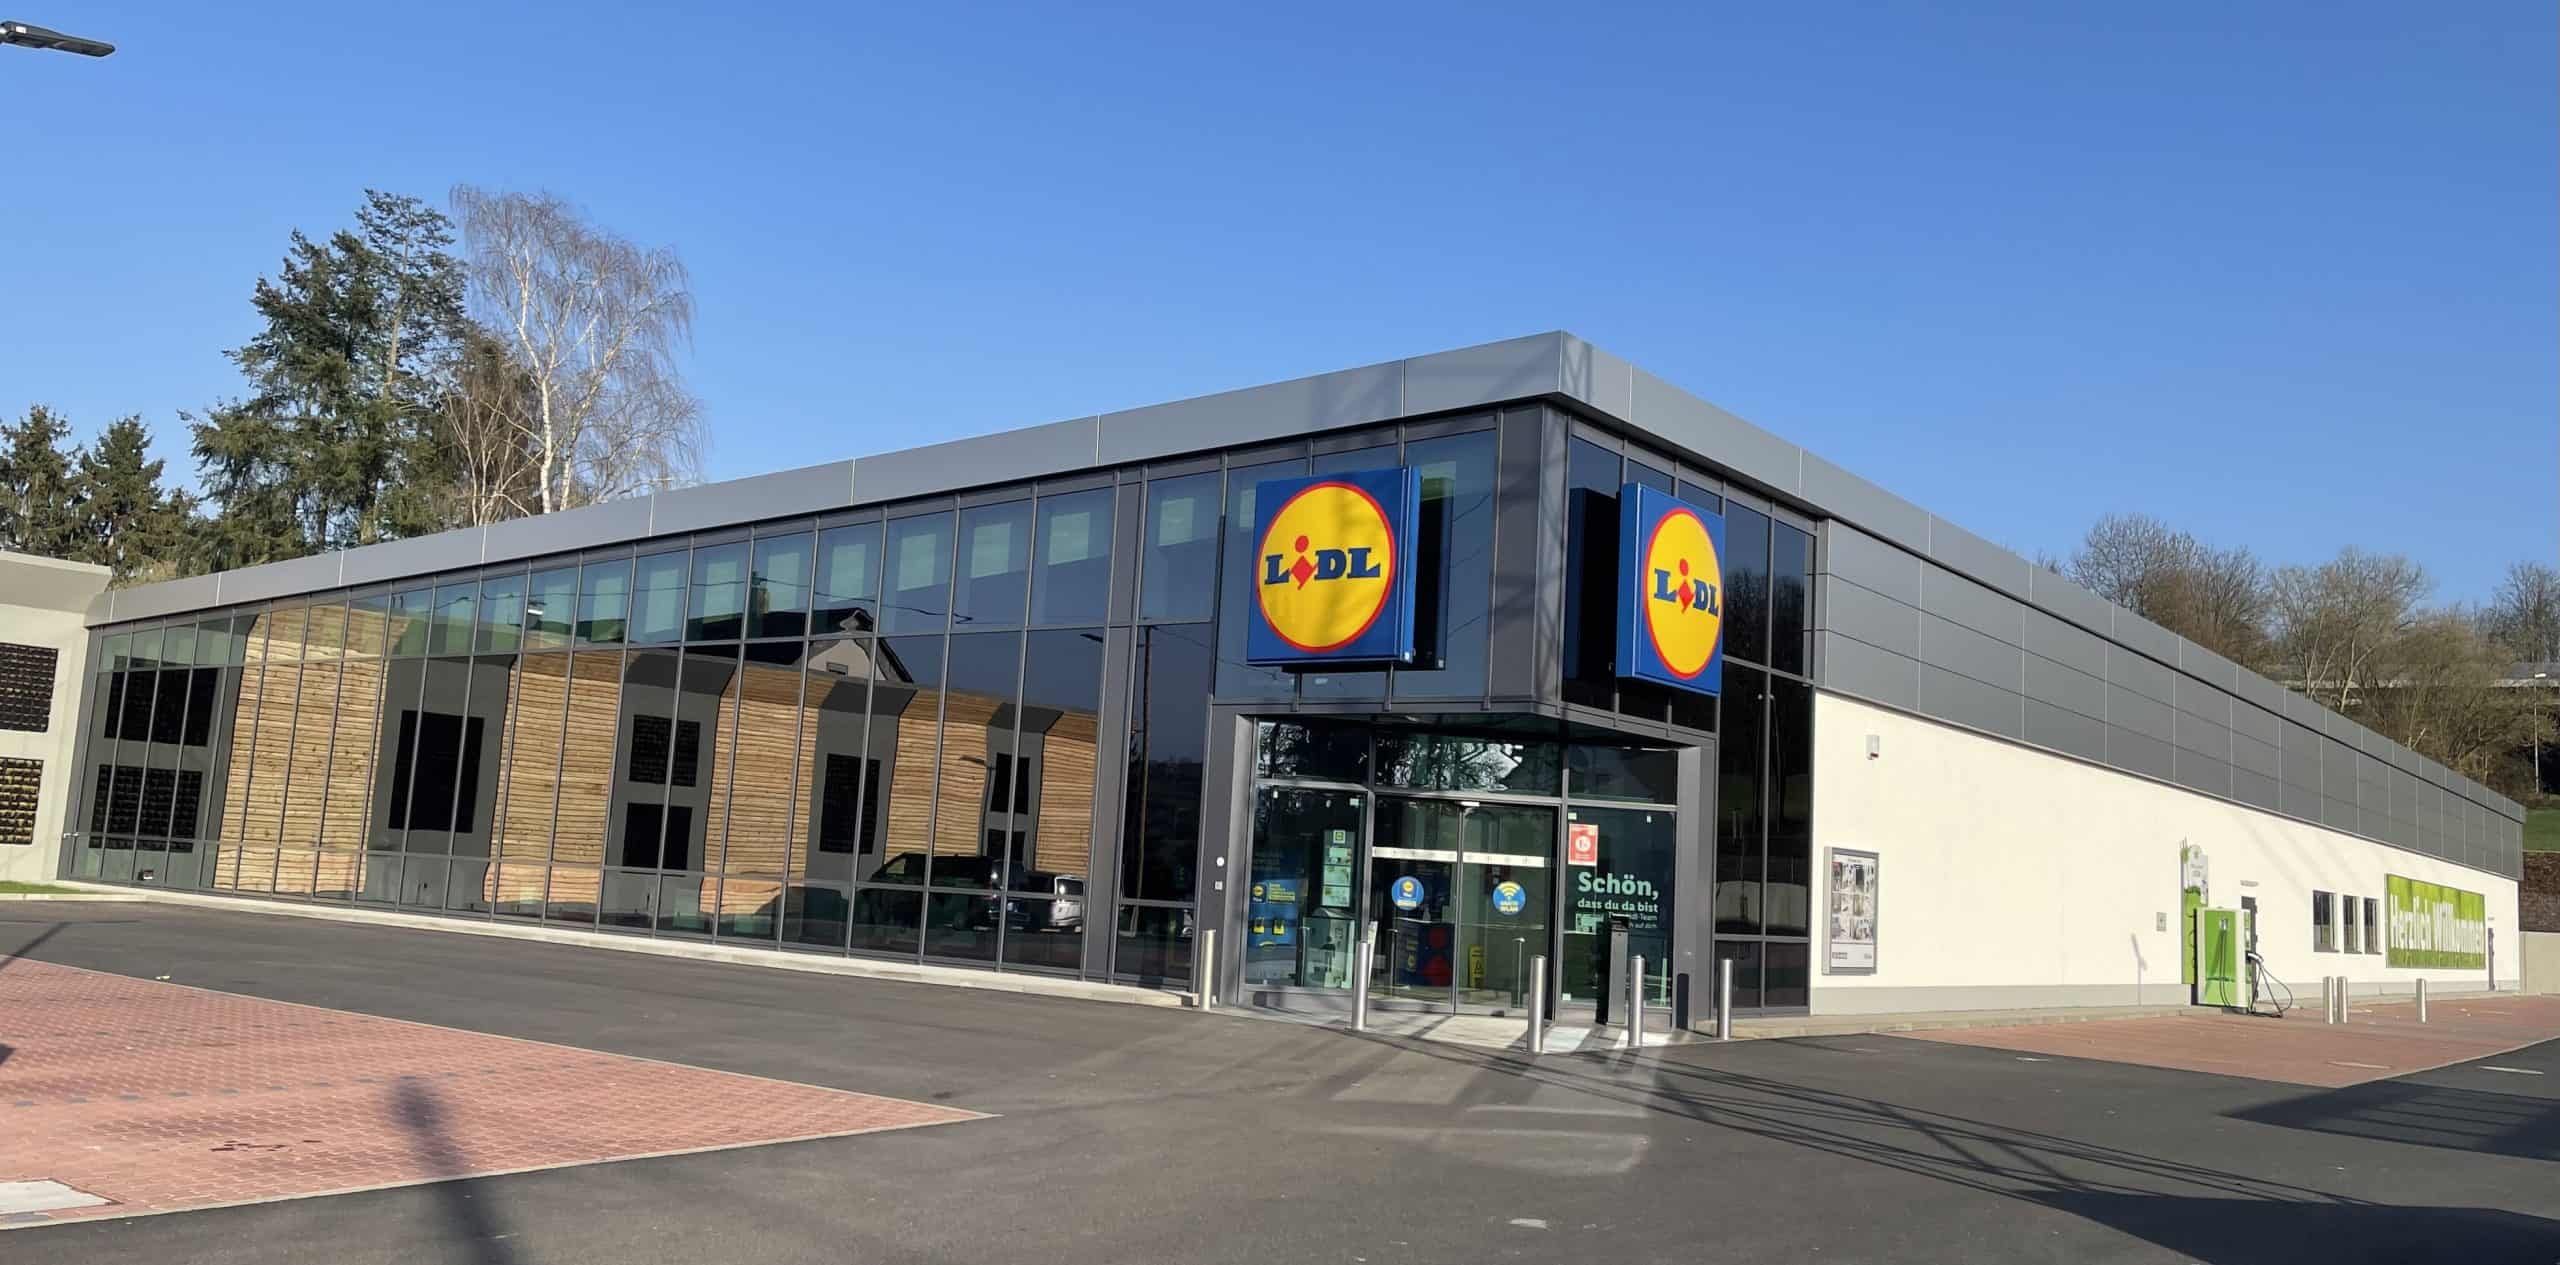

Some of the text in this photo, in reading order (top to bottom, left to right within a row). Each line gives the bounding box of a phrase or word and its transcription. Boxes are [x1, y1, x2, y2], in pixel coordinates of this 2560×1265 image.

[1578, 871, 1659, 900] Schön,
[1577, 898, 1658, 913] dass du da bist
[2389, 893, 2432, 951] Herzlich
